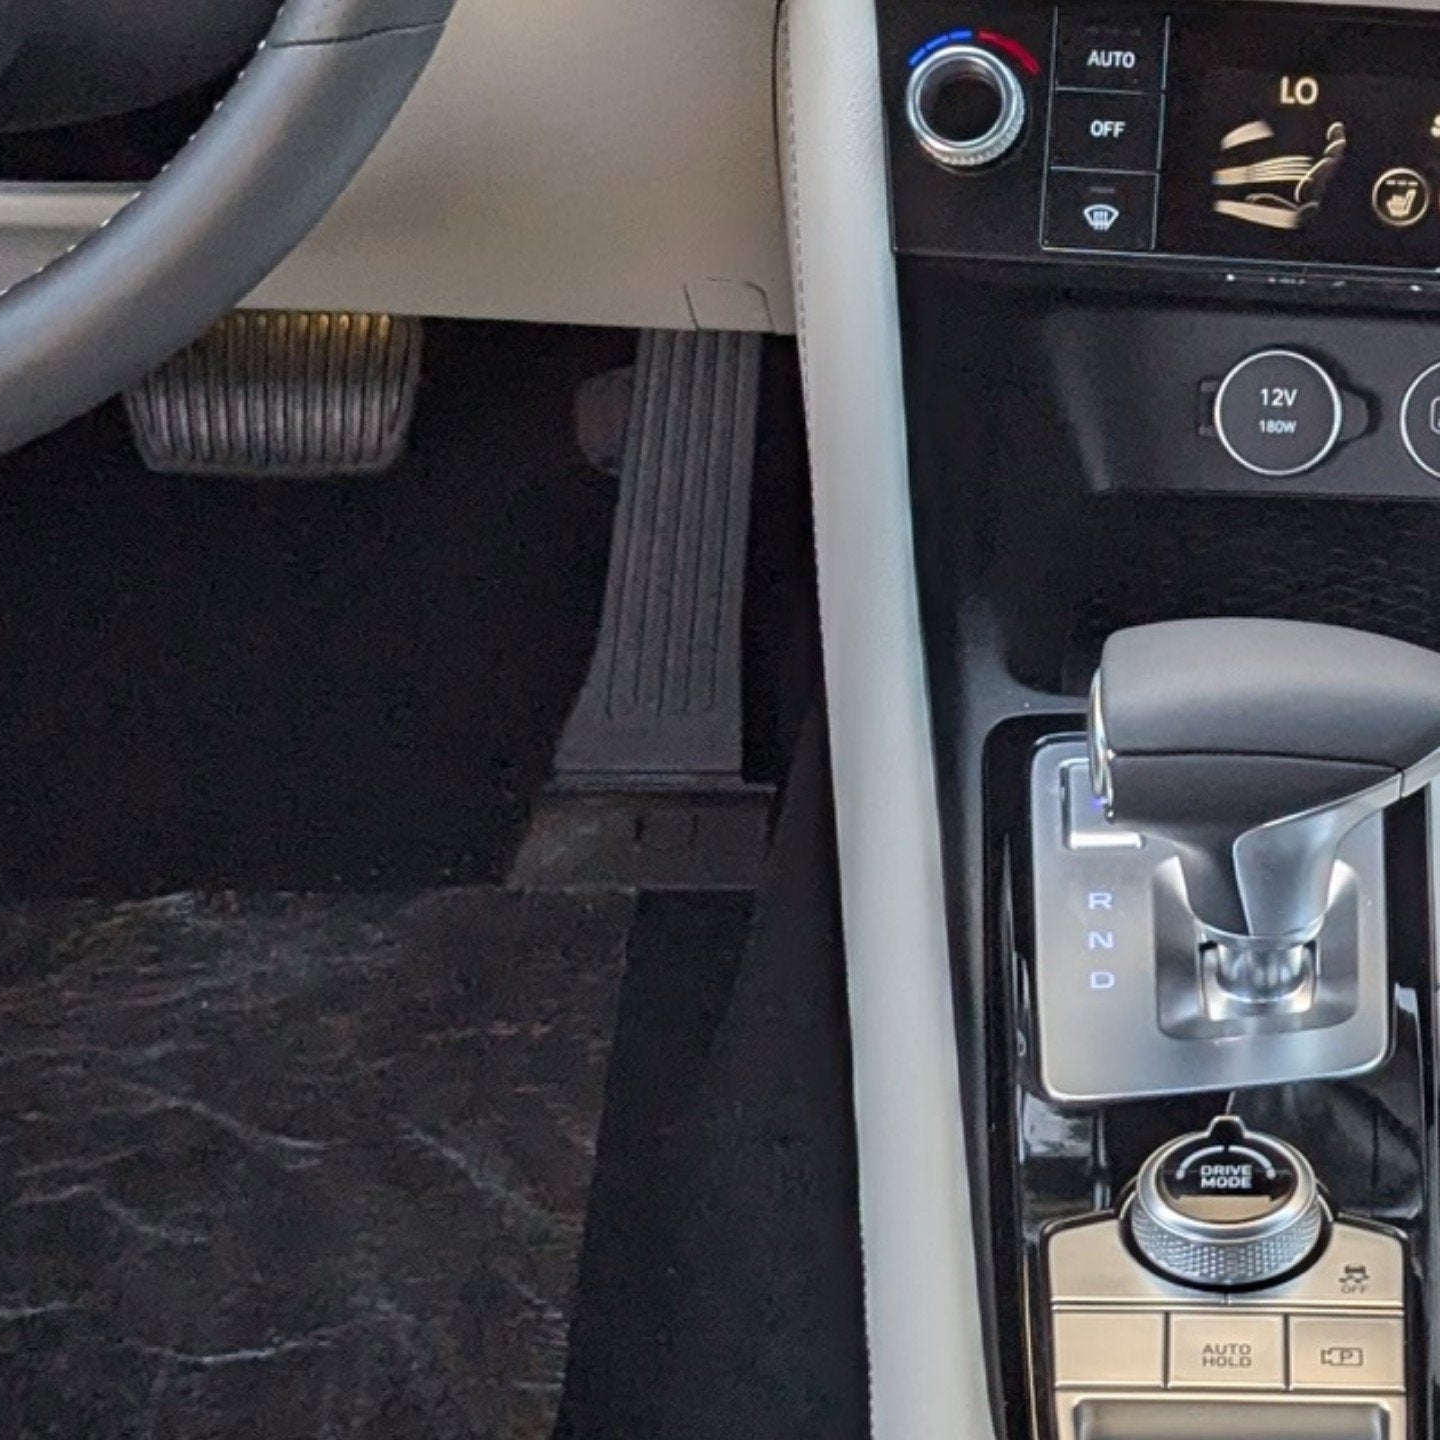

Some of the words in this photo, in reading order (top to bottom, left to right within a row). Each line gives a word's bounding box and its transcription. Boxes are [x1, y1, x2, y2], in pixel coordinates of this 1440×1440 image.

[1087, 49, 1136, 70] AUTO
[1280, 75, 1320, 106] LO
[1090, 120, 1126, 139] OFF
[1260, 388, 1298, 408] 12V
[1259, 419, 1298, 436] 180W
[1088, 892, 1114, 911] R
[1088, 930, 1114, 950] N
[1090, 971, 1116, 990] D
[1199, 1164, 1253, 1178] DRIVE
[1199, 1176, 1254, 1190] MODE
[1340, 1283, 1368, 1295] OFF
[1202, 1344, 1252, 1356] AUTO
[1202, 1356, 1252, 1368] HOLD
